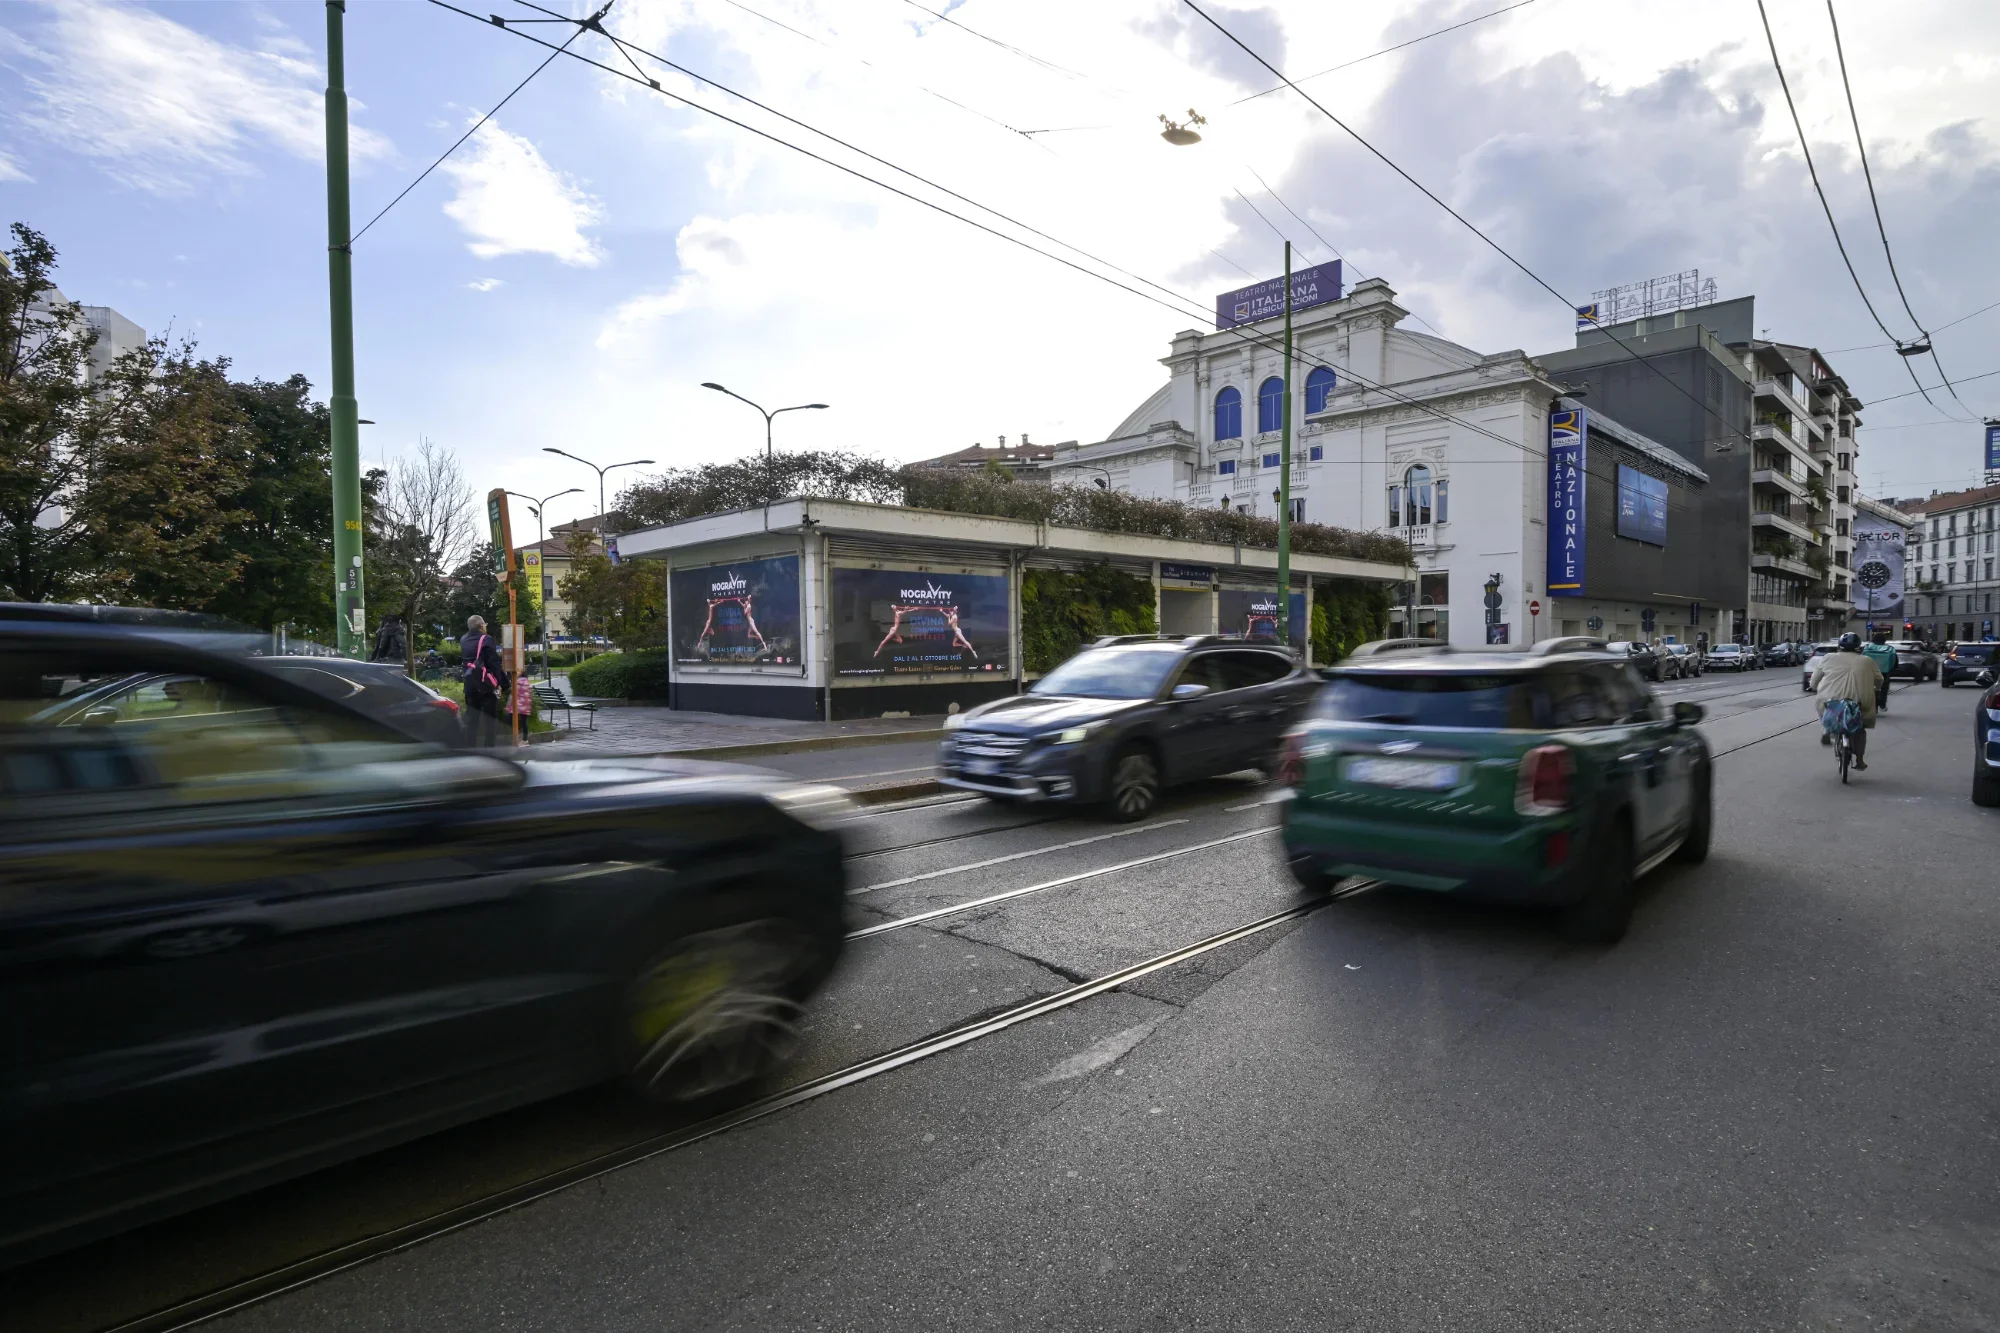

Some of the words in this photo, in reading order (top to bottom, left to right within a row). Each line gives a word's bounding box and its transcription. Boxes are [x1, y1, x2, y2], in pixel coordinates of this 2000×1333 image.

[1235, 285, 1267, 301] TEATRO
[1268, 269, 1319, 291] NAZONALE
[1251, 282, 1318, 309] ITALIANA
[1605, 277, 1718, 313] ITALIANA
[1554, 453, 1562, 508] TEATRO
[1565, 451, 1577, 578] NAZIONALE
[711, 571, 747, 592] NOGRAVITY
[900, 580, 952, 600] NOGRAVITY
[1251, 597, 1278, 611] NOGRAVITY
[909, 616, 945, 626] DIVINA
